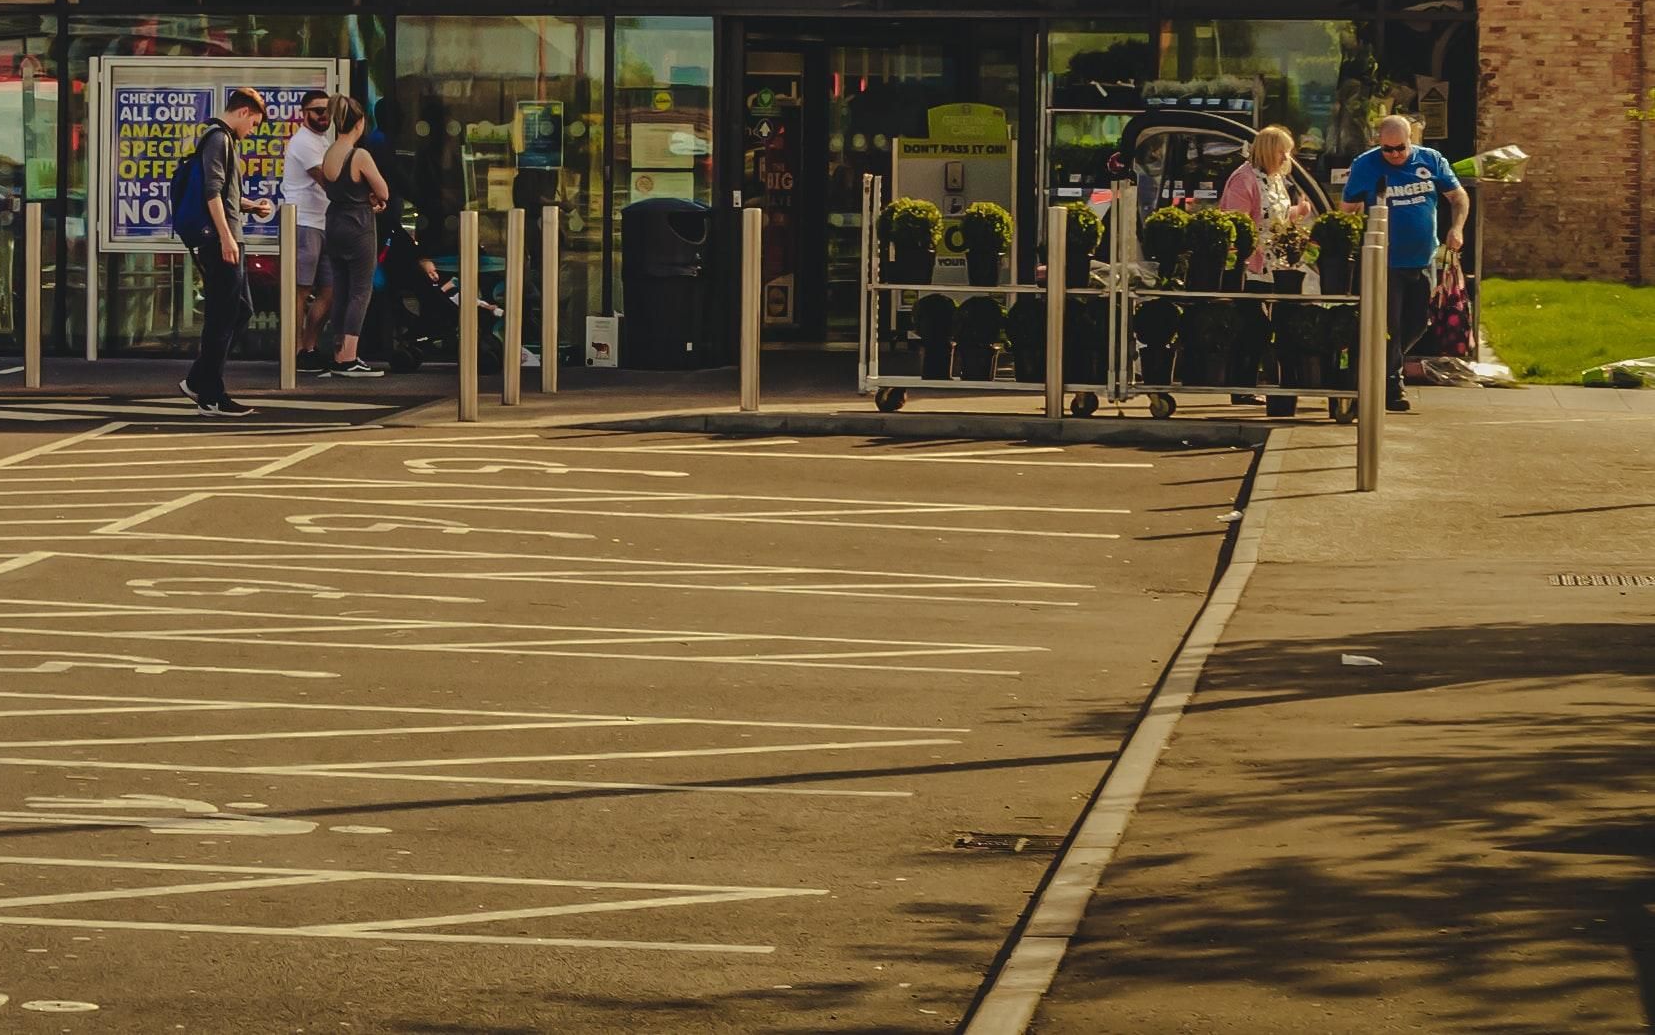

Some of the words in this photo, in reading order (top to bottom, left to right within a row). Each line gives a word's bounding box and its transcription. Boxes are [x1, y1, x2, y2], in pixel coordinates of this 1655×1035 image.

[119, 93, 165, 105] CHECK
[167, 93, 196, 106] OUT
[277, 91, 307, 103] OUT
[120, 106, 153, 121] ALL
[155, 106, 196, 122] OUR
[119, 140, 197, 158] SPECIA
[903, 143, 939, 155] DON'T
[942, 143, 969, 155] PASS
[972, 143, 985, 155] IT
[986, 143, 1007, 155] ON!
[118, 159, 178, 180] OFFE
[118, 181, 171, 197] IN-ST
[766, 171, 793, 191] BIG
[1385, 180, 1434, 198] ANGERS
[118, 198, 173, 225] NO
[937, 257, 966, 267] YOUR
